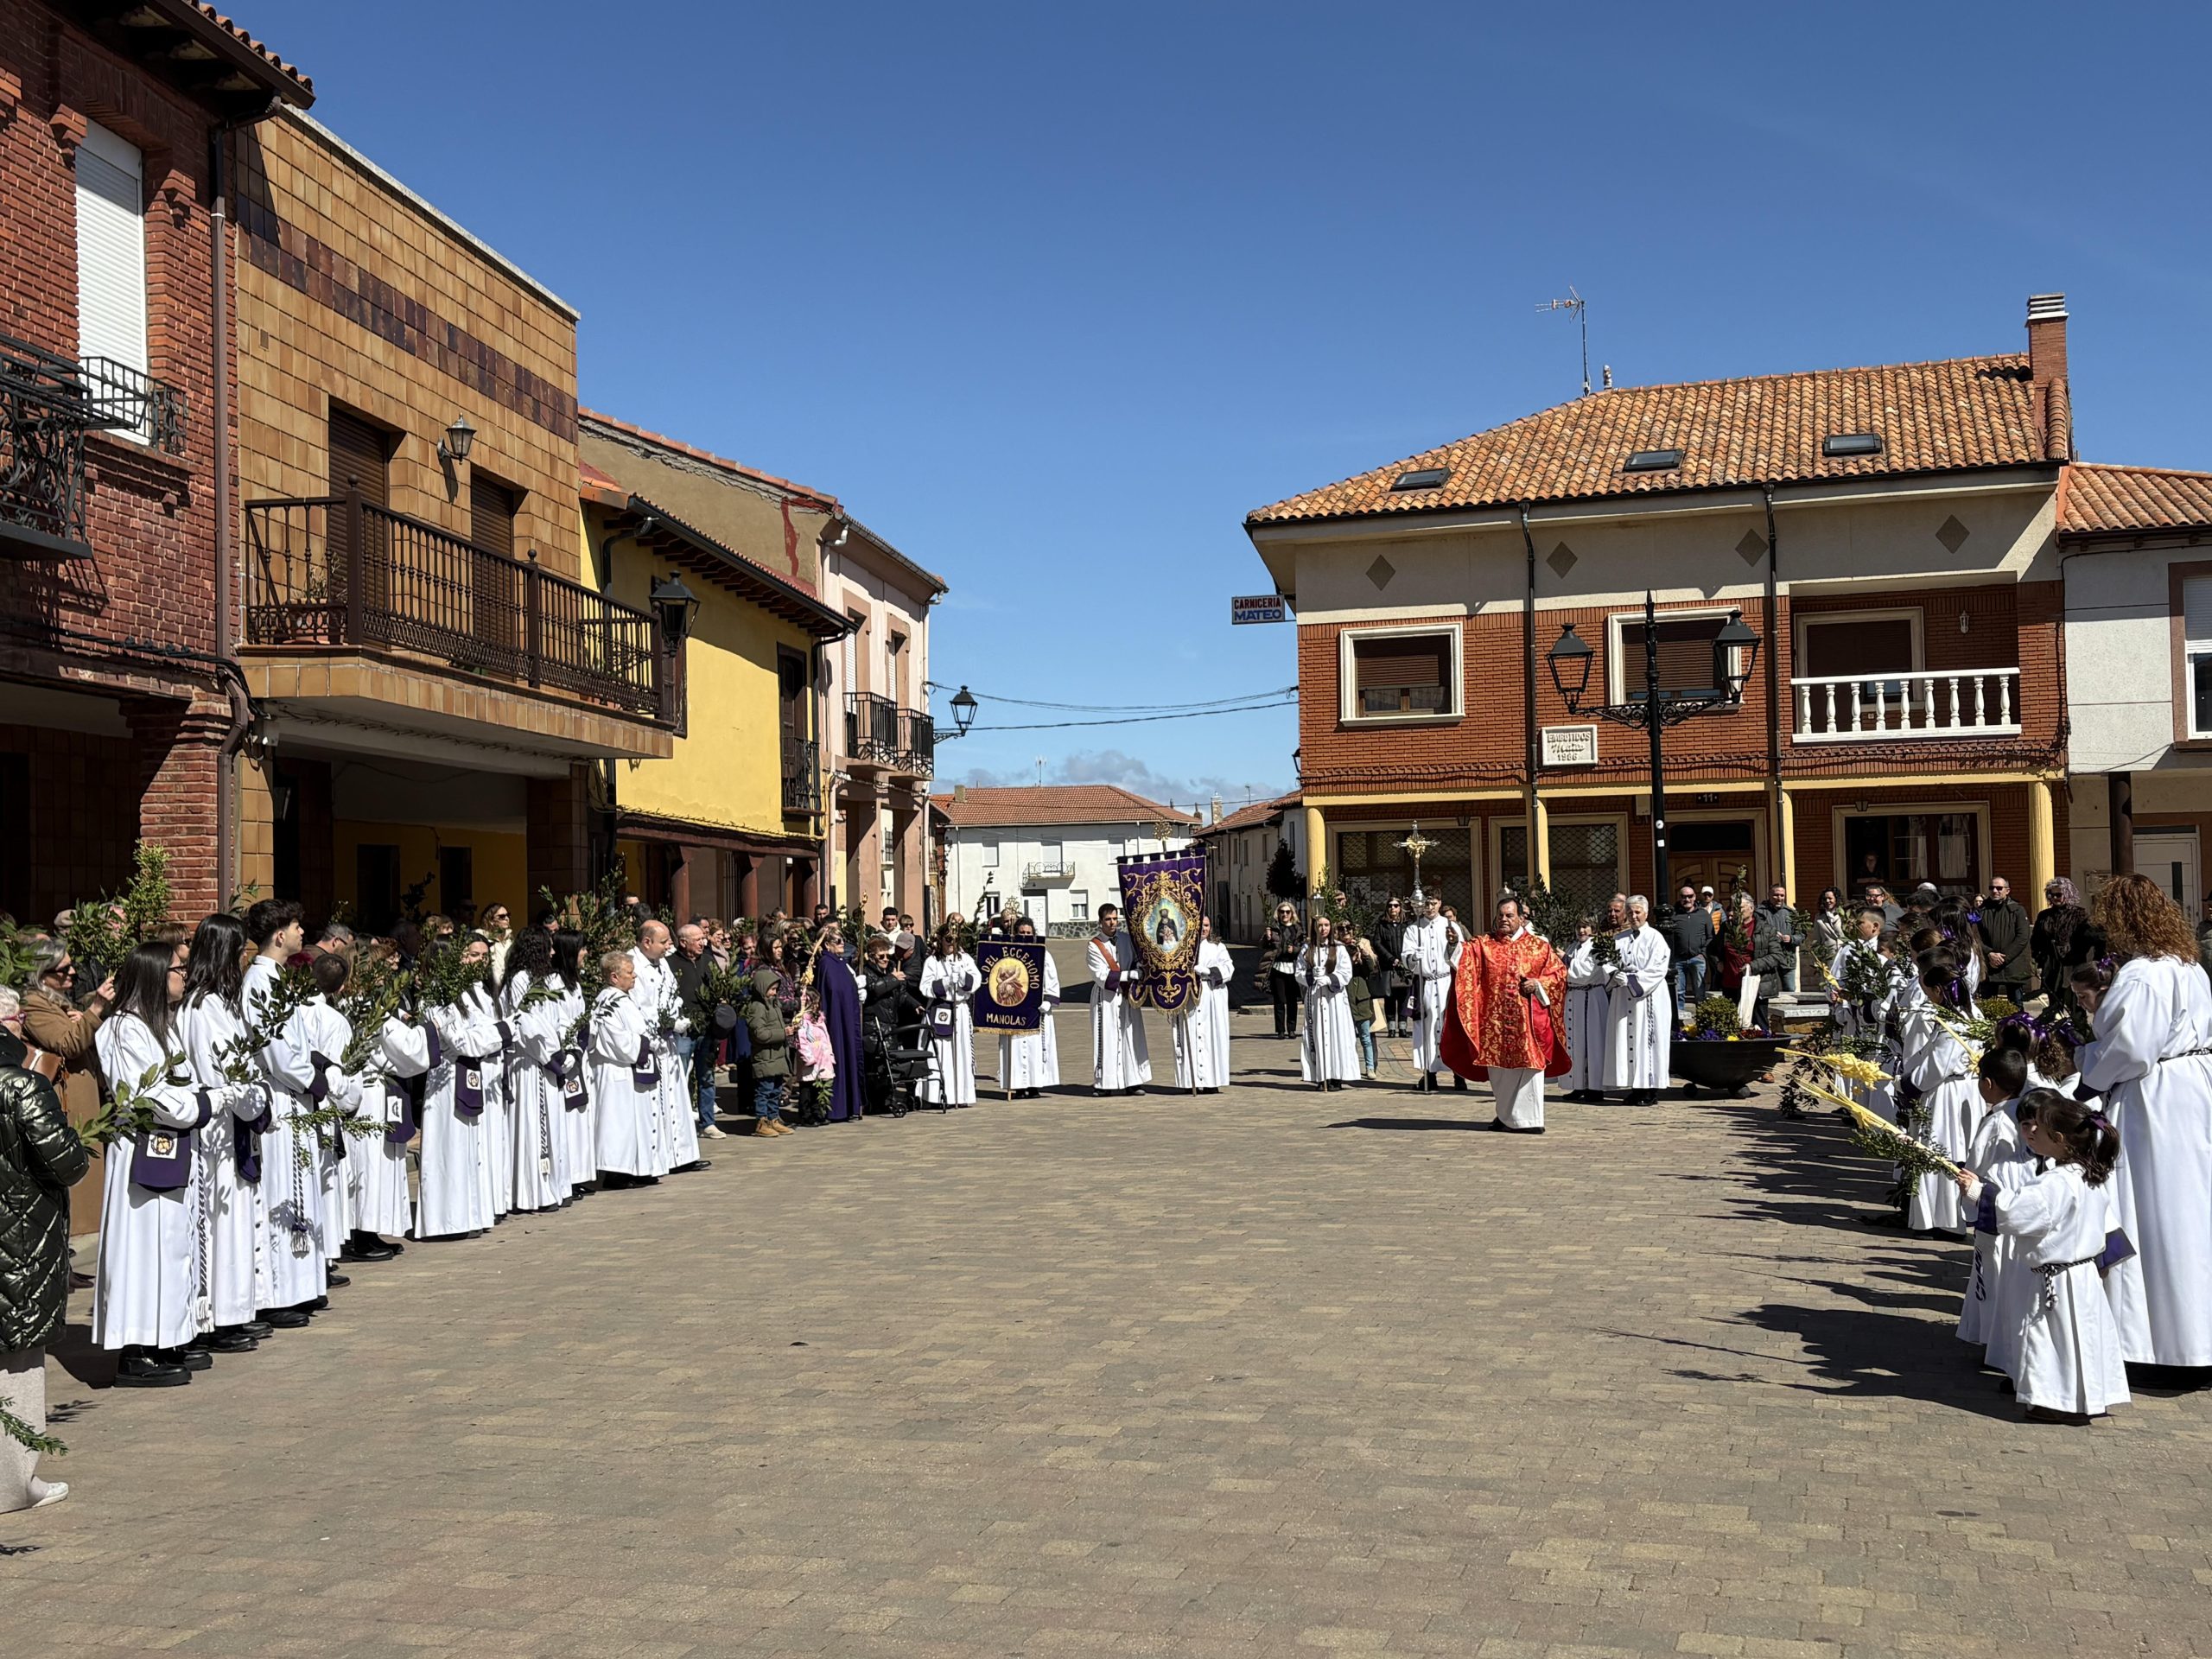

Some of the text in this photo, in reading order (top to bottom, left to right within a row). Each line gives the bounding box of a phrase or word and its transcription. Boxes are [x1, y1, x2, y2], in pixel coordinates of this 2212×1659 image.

[1235, 598, 1281, 609] CARNICERIA
[1235, 609, 1281, 620] MATEO
[1703, 793, 1713, 802] 11
[981, 955, 999, 973] DEL
[986, 1013, 1026, 1026] MANOLAS
